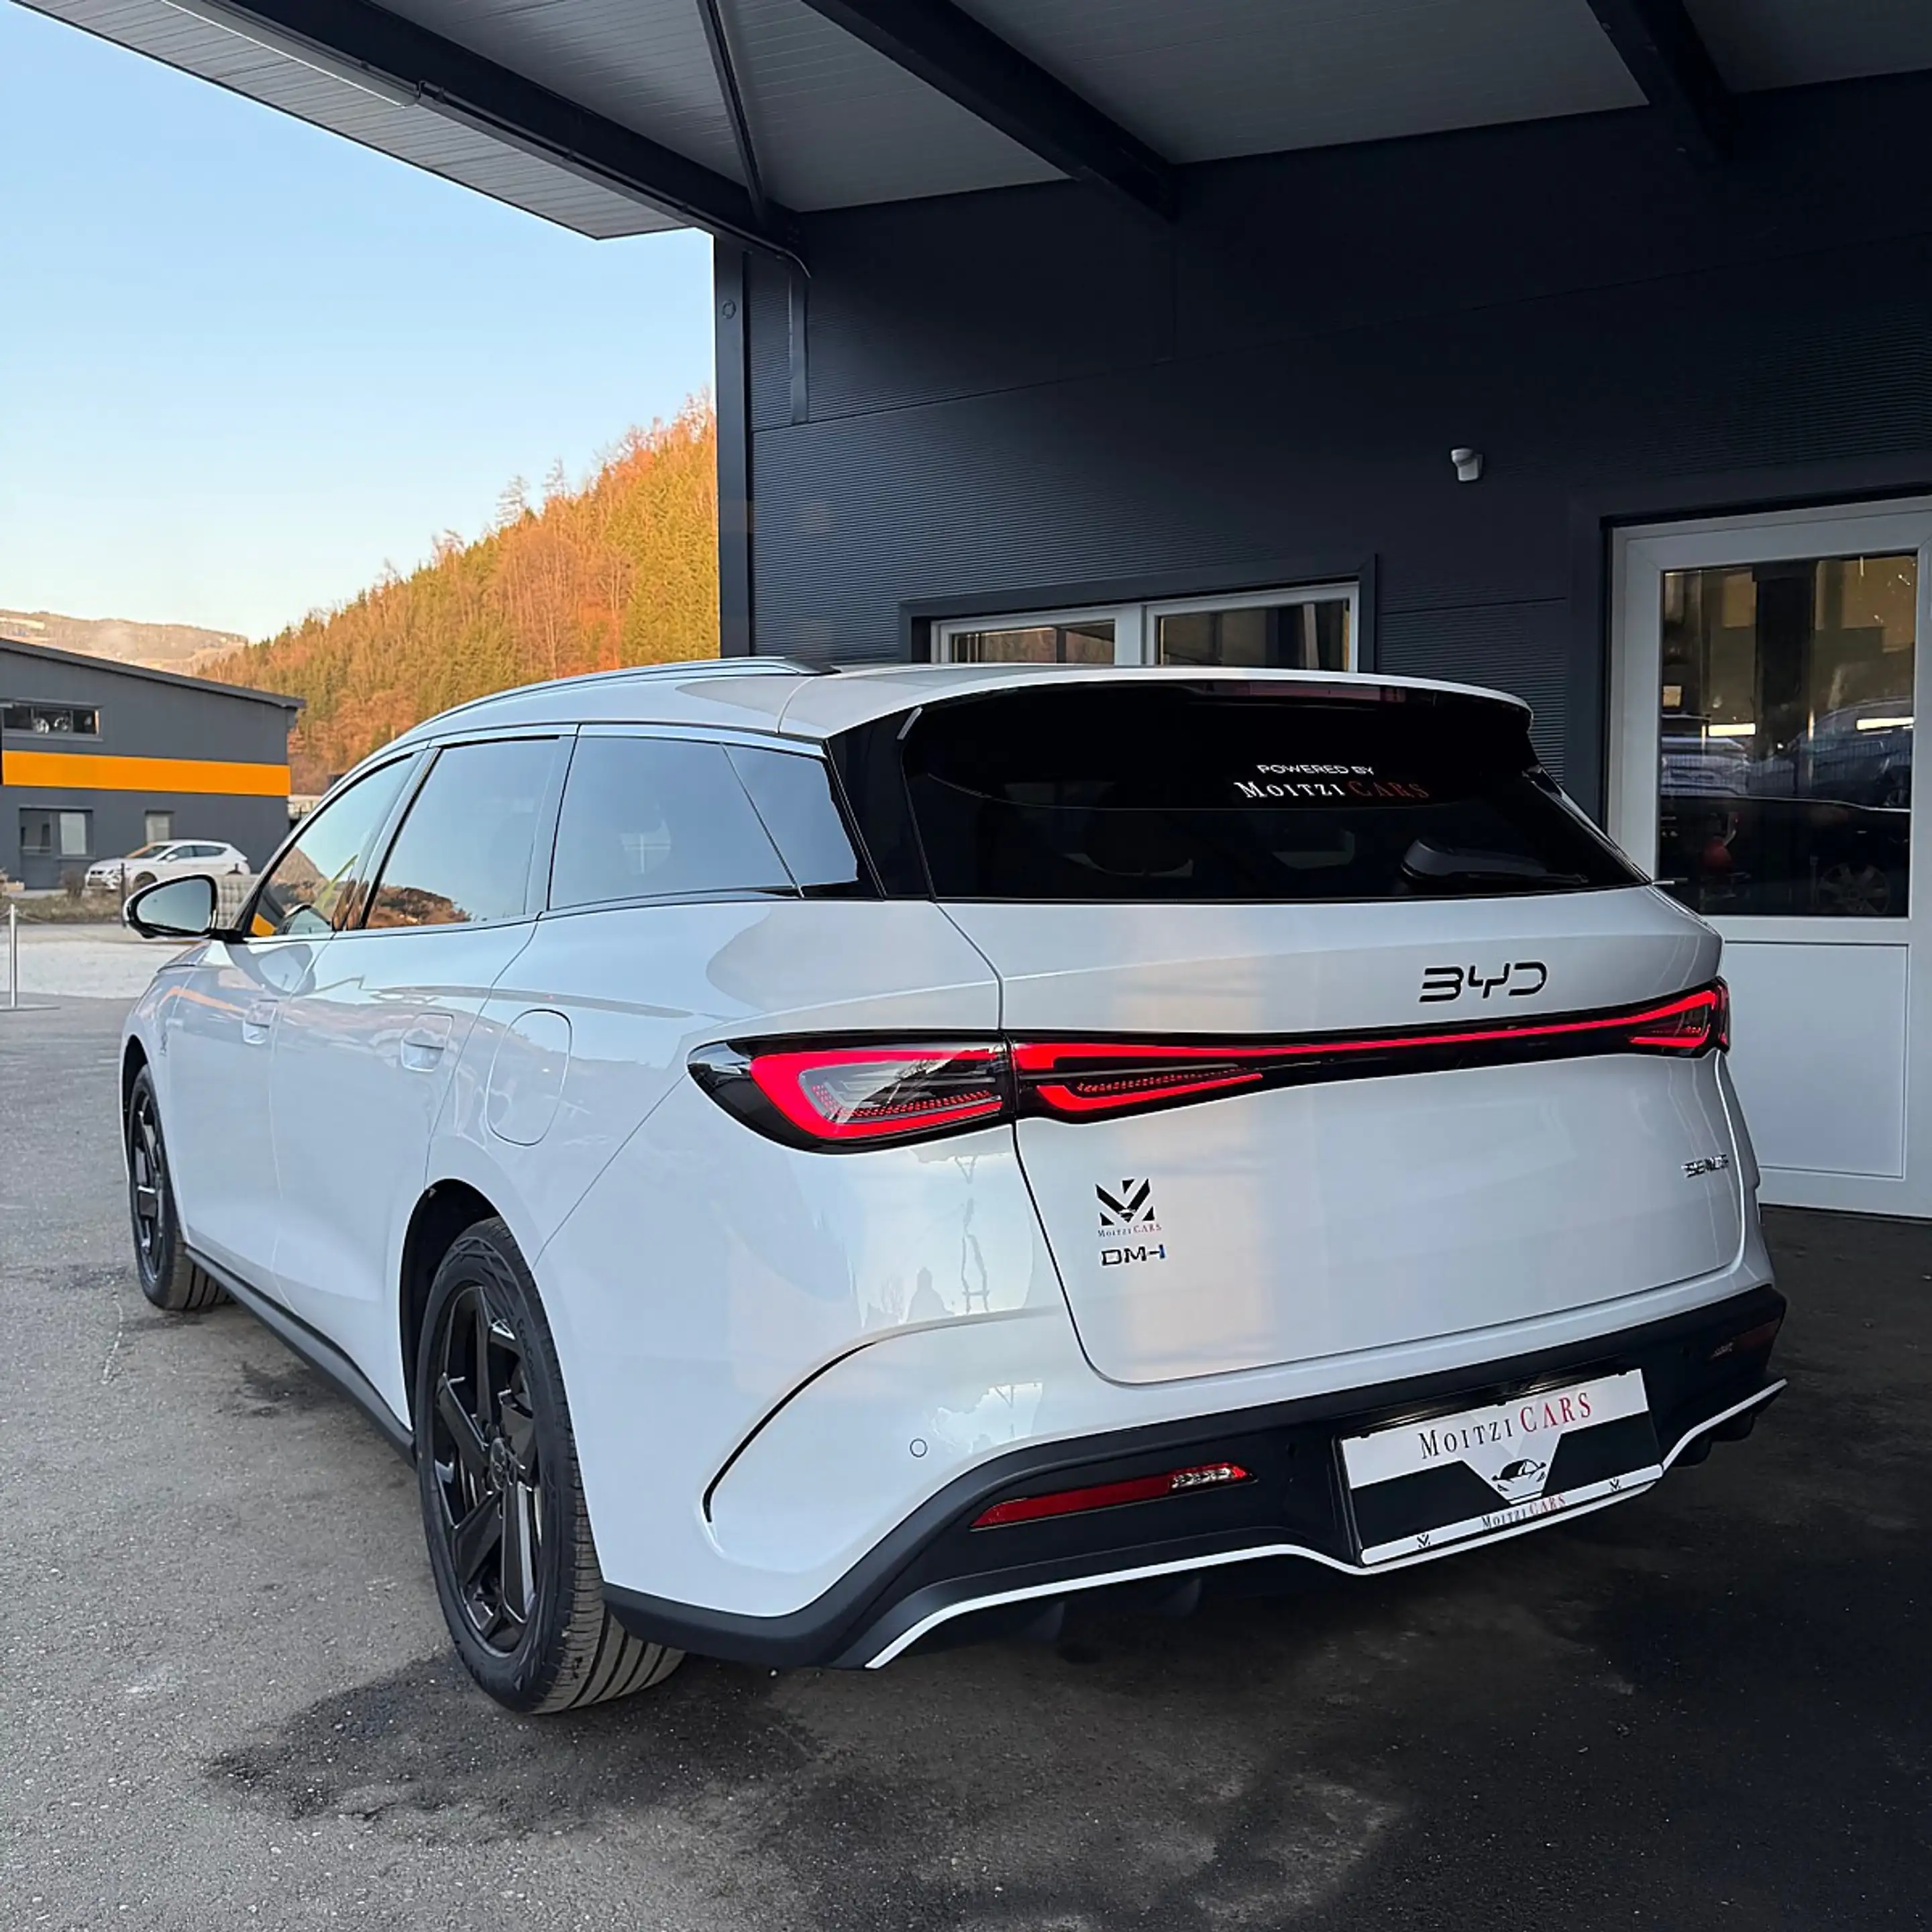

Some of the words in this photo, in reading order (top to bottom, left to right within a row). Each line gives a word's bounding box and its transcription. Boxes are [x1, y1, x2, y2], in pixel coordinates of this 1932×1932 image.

[1256, 763, 1349, 774] POWERED
[1350, 765, 1375, 775] BY
[1233, 781, 1346, 798] MOITZI
[1347, 780, 1430, 798] CARS
[1418, 961, 1548, 1002] BYD
[1133, 1223, 1162, 1233] CARS
[1417, 1418, 1513, 1460] MOITZI
[1519, 1391, 1593, 1434] CARS
[1529, 1493, 1566, 1515] CARS
